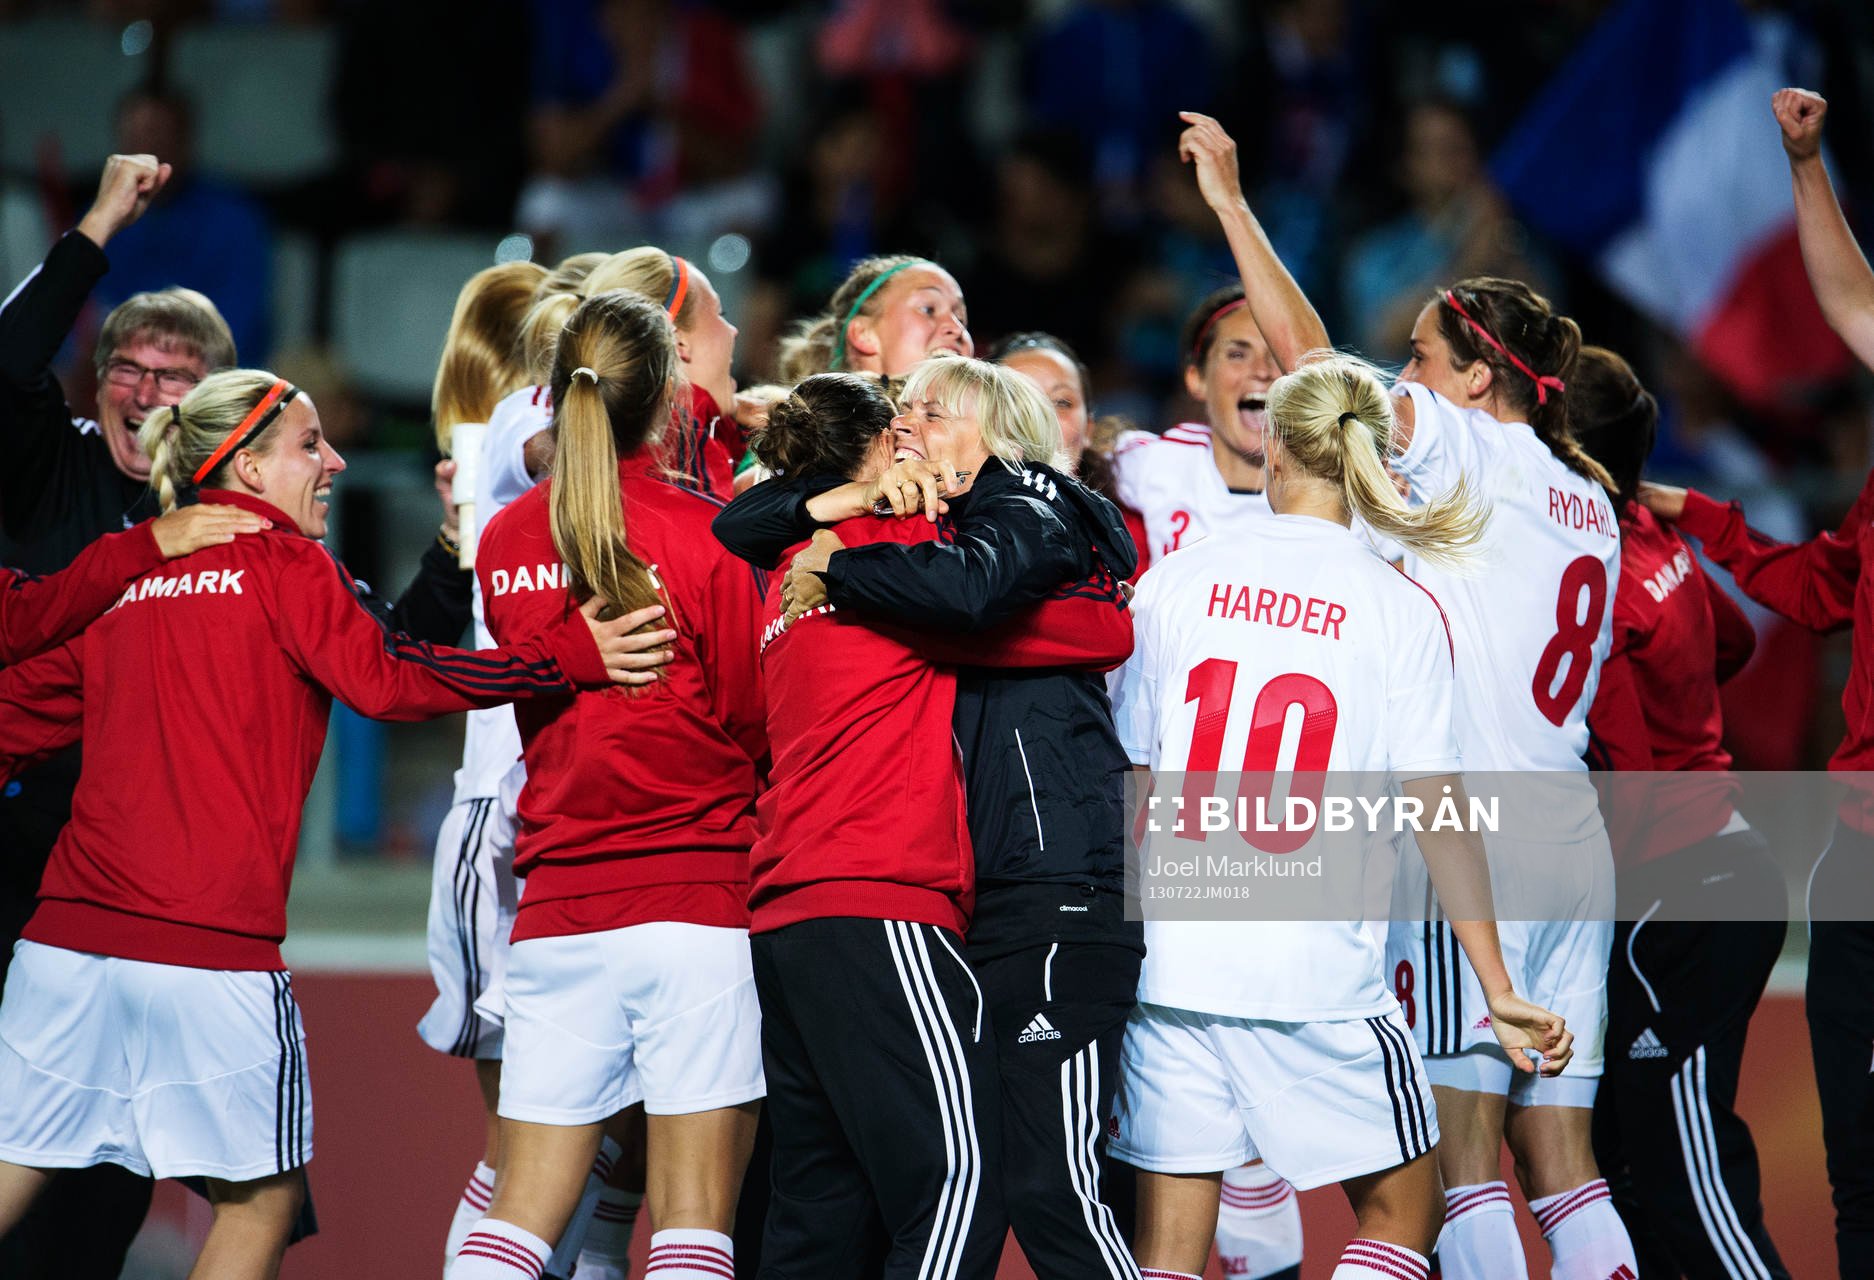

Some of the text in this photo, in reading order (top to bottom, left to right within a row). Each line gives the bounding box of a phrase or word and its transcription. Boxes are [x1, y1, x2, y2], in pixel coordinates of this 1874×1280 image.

[103, 569, 245, 615] ANMARK
[1207, 583, 1347, 641] HARDER
[1531, 555, 1608, 728] 8
[1175, 656, 1338, 855] 10
[1394, 959, 1417, 1031] 8
[1018, 1029, 1062, 1044] adidas
